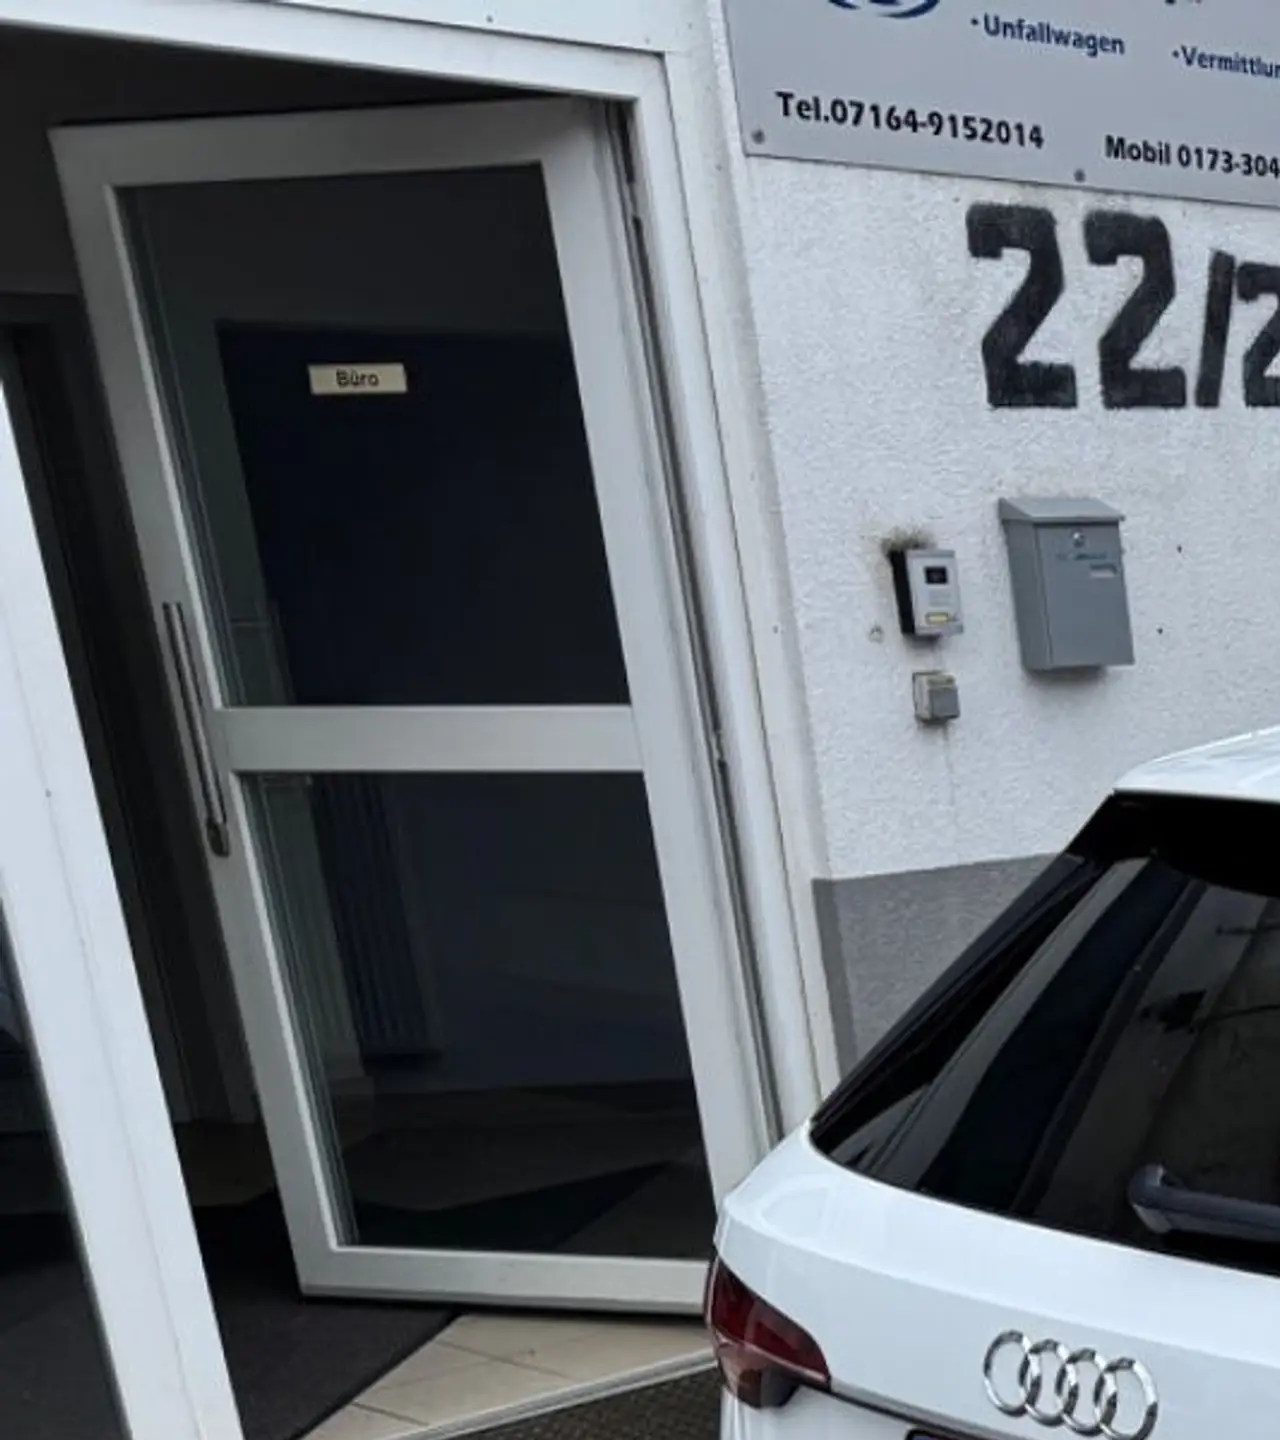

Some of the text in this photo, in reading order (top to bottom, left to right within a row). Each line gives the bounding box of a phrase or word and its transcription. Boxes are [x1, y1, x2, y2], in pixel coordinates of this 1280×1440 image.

[984, 13, 1125, 57] Unfallwagen
[775, 90, 1045, 150] Tel.07164-9152014
[1105, 134, 1171, 166] Mobil
[335, 367, 380, 388] Büro
